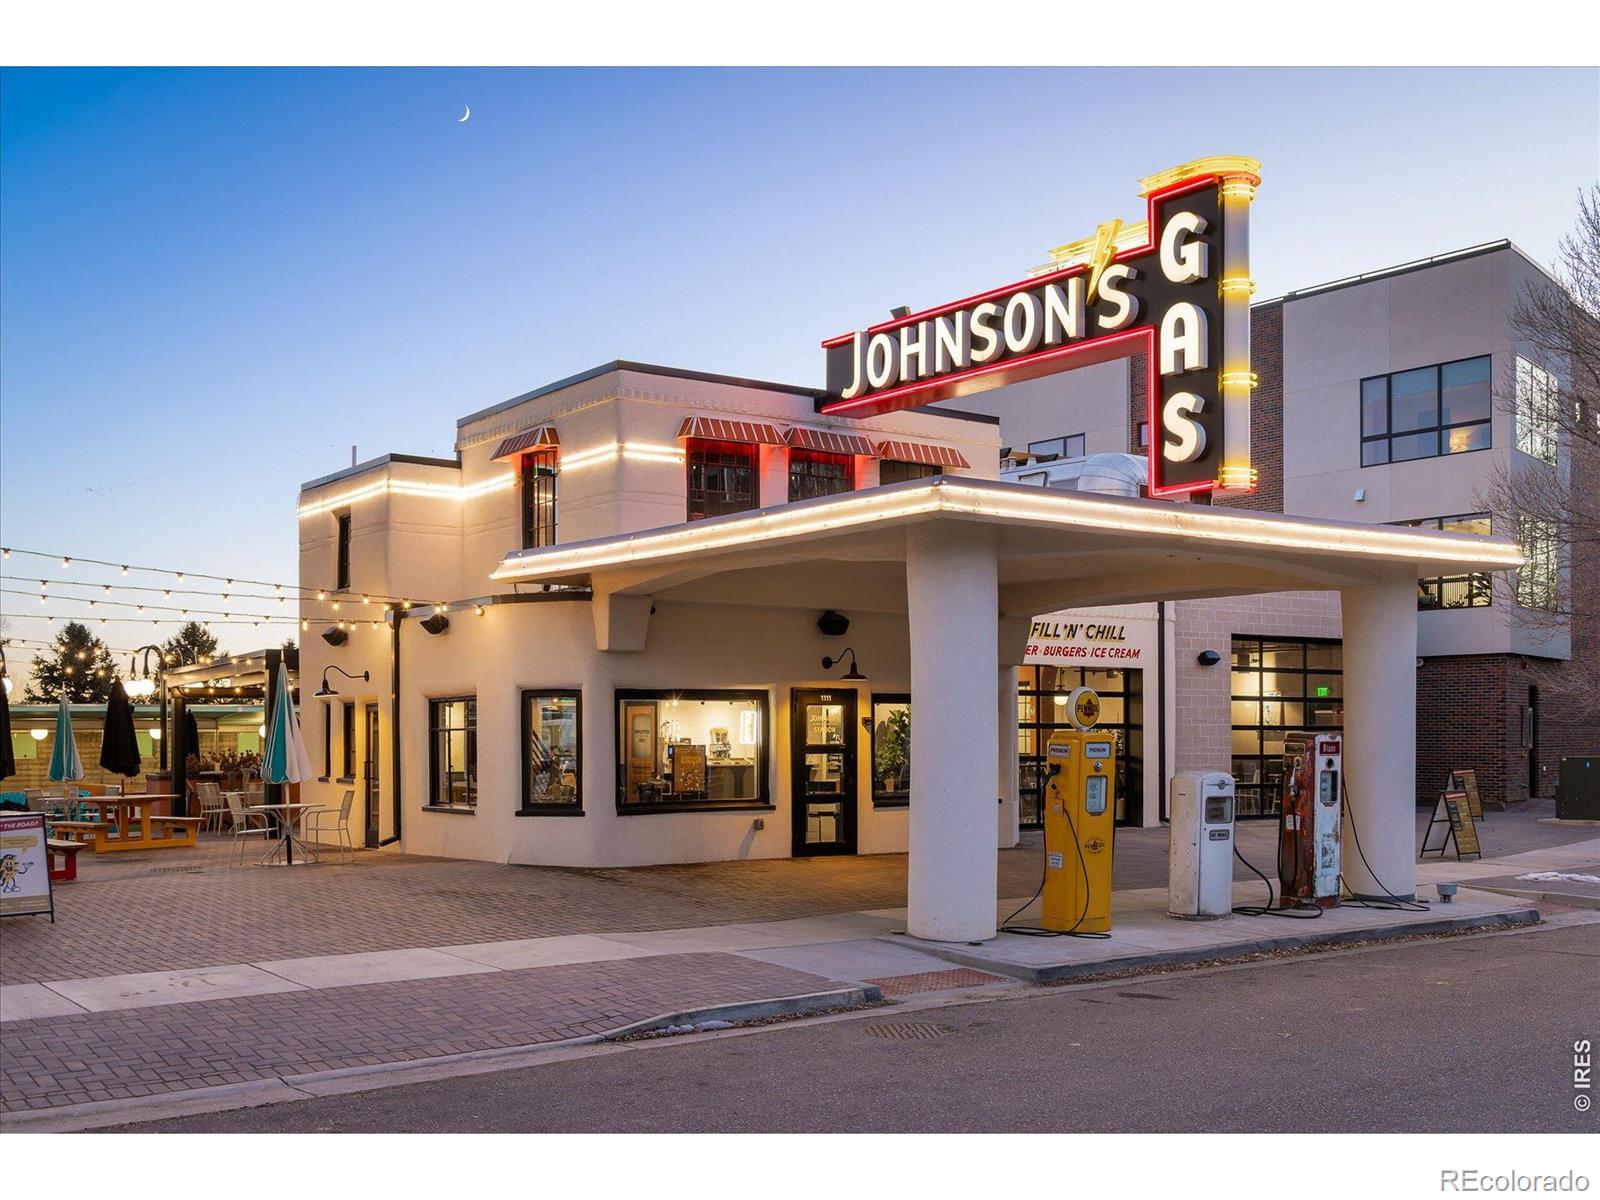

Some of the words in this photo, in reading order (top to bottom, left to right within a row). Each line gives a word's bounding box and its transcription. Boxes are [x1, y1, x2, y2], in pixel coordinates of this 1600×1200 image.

[1159, 211, 1209, 464] GAS
[1030, 622, 1061, 638] FILL
[1085, 624, 1126, 641] CHILL
[1043, 646, 1087, 658] BURGERS
[1090, 647, 1108, 658] ICE
[1108, 648, 1141, 659] CREAM
